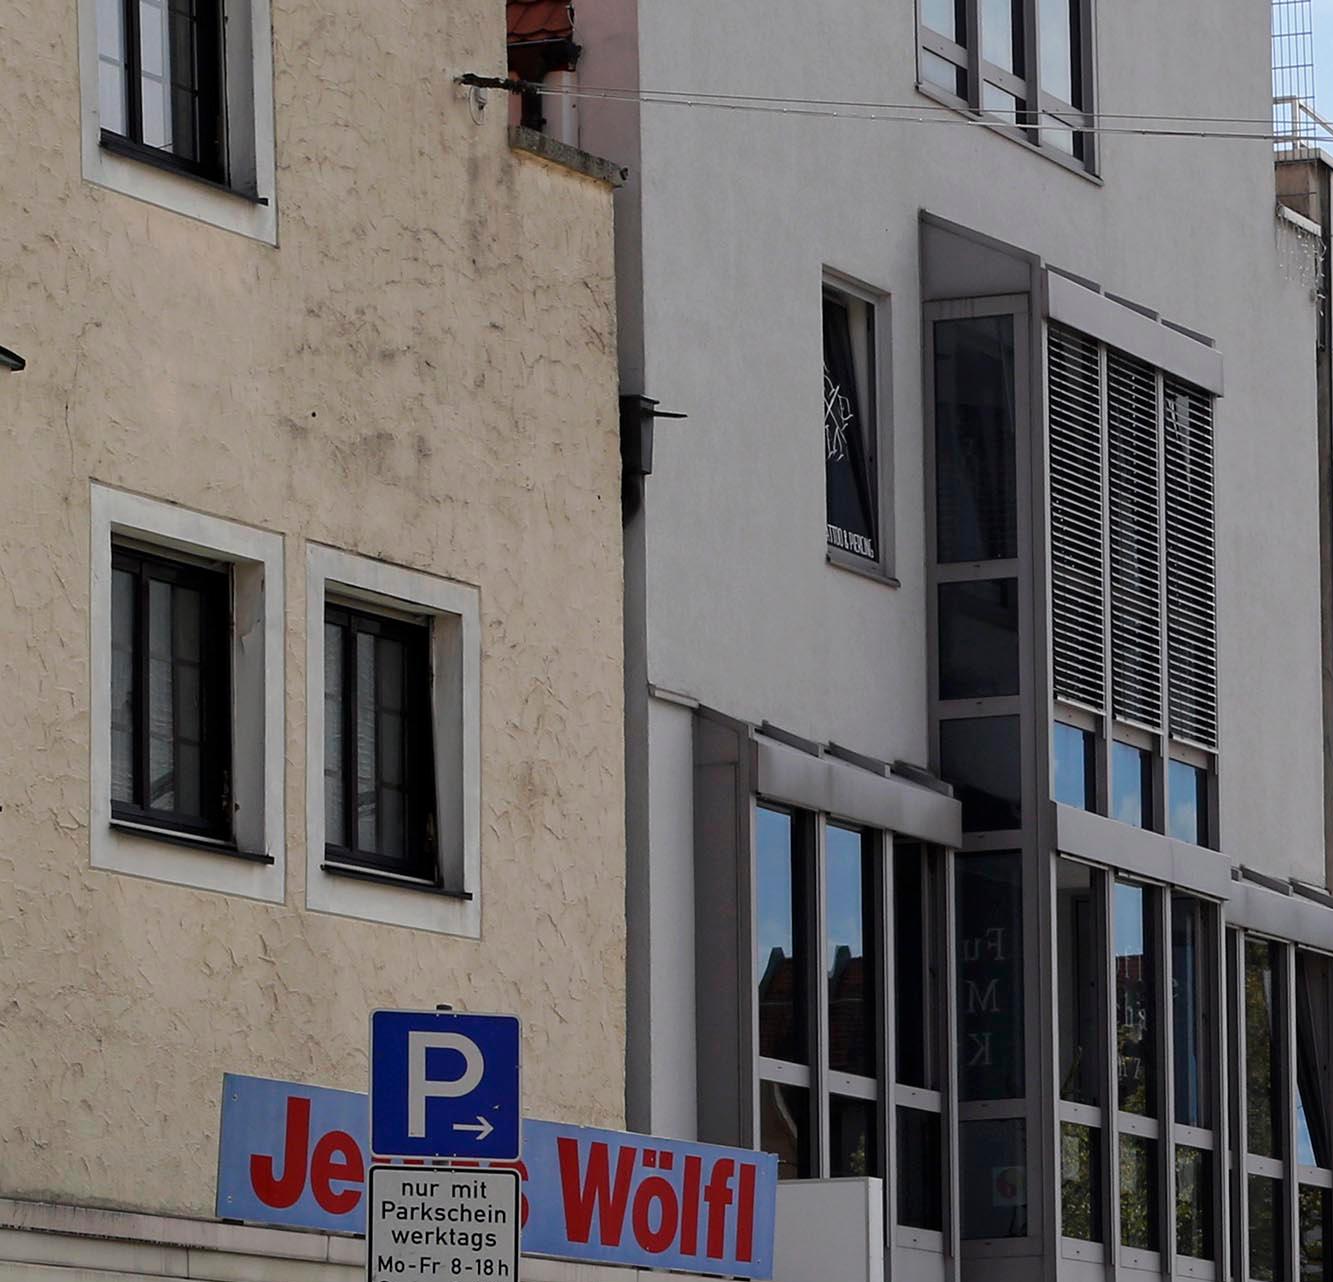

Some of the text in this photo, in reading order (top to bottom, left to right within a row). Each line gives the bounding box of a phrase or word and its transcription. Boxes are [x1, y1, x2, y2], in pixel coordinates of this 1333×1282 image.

[848, 531, 875, 559] PIERCING
[407, 1030, 485, 1138] P
[401, 1179, 487, 1199] nur mit
[556, 1135, 757, 1264] Wölfl
[381, 1200, 507, 1224] Parkschein
[391, 1226, 497, 1252] werktags
